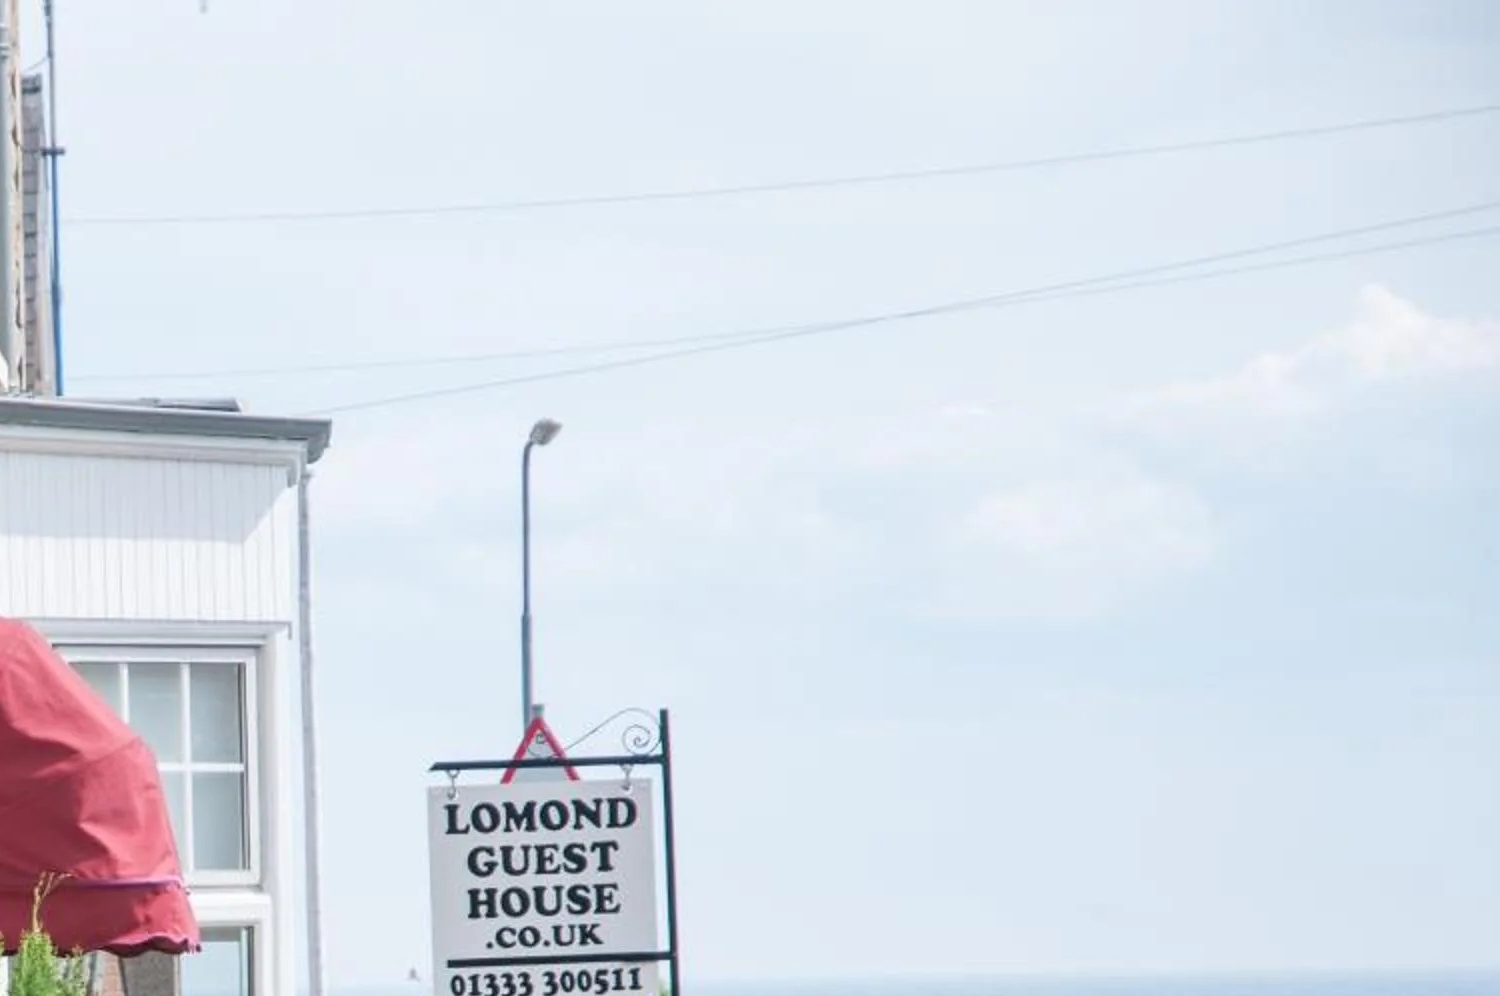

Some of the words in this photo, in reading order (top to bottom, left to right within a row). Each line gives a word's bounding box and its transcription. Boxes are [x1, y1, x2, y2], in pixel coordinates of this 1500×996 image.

[444, 797, 638, 835] LOMOND
[466, 840, 619, 877] GUEST
[466, 883, 621, 919] HOUSE
[485, 923, 603, 949] .CO.UK
[543, 967, 643, 996] 300511
